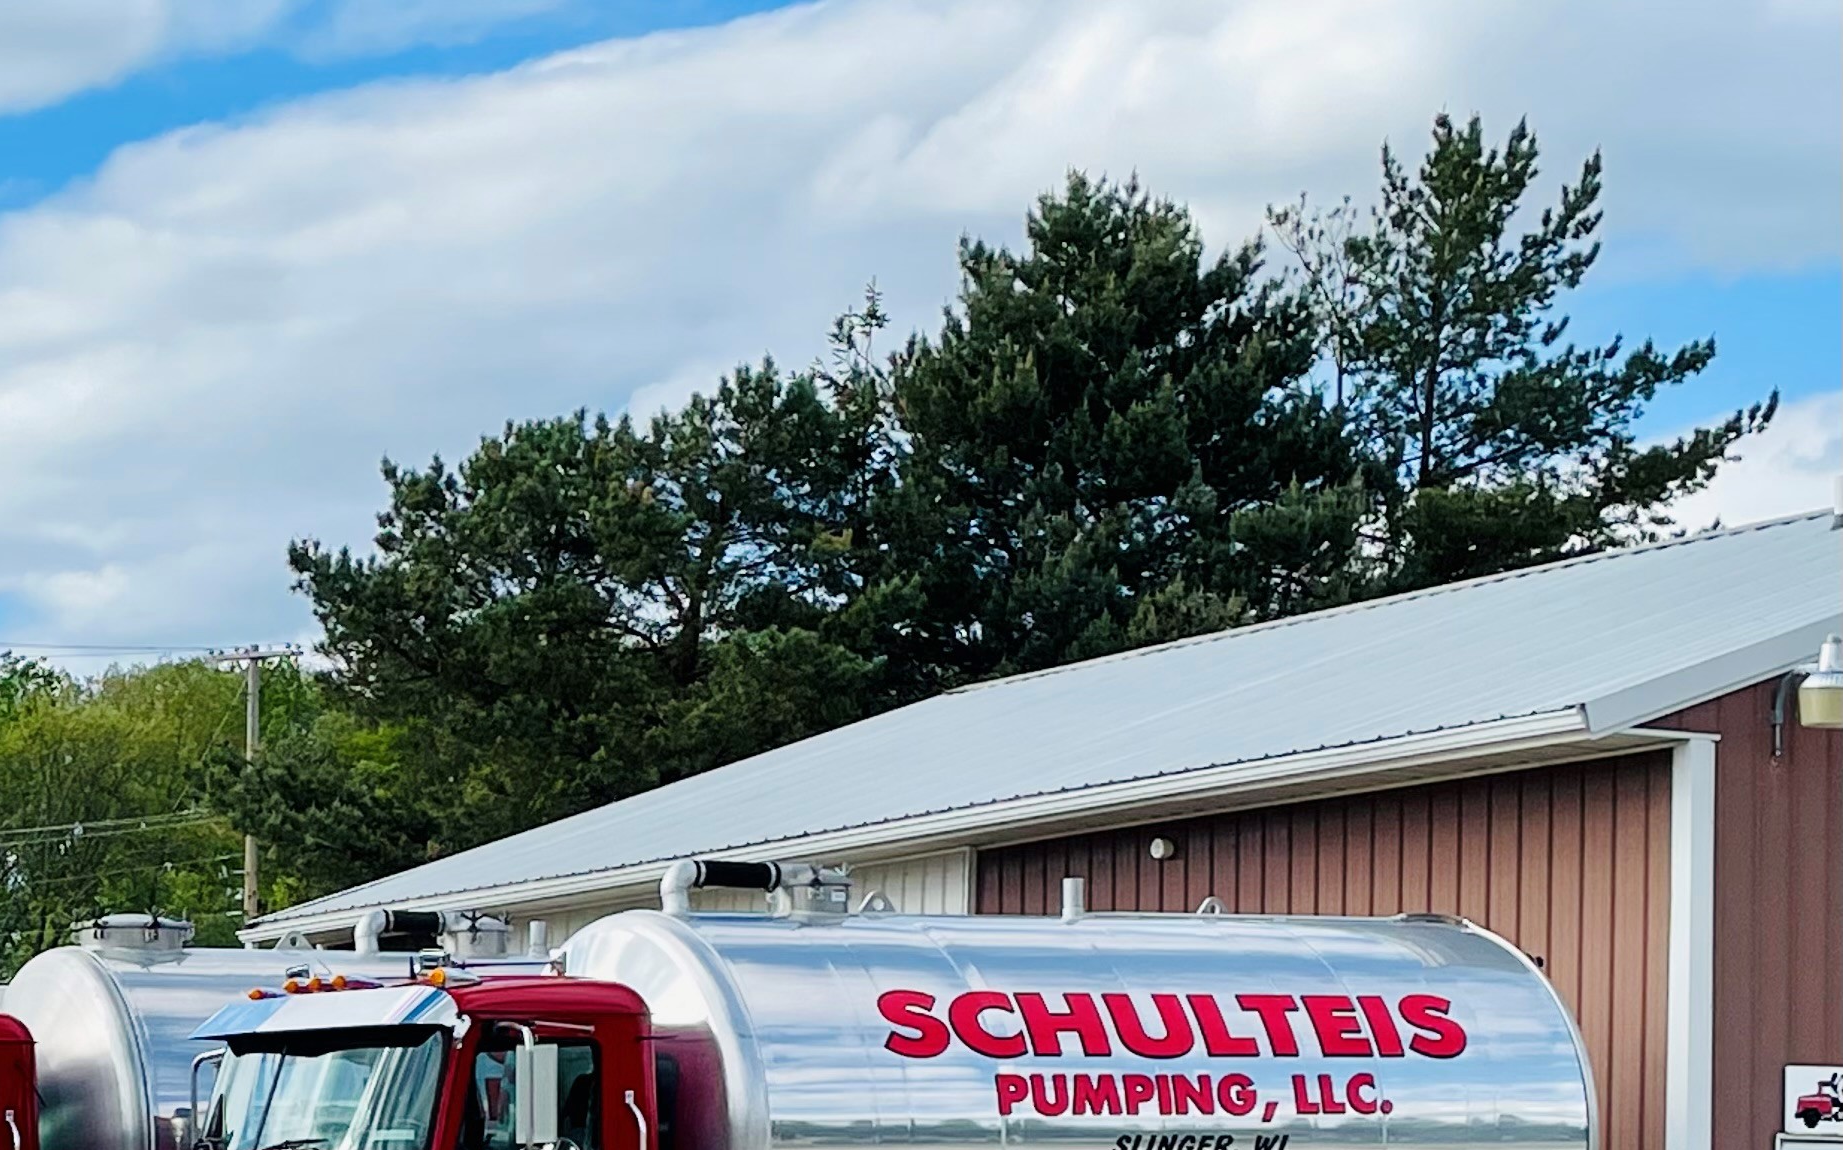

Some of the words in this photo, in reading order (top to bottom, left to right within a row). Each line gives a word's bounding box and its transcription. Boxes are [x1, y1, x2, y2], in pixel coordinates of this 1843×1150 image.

[876, 990, 1468, 1060] SCHULTEIS
[994, 1072, 1278, 1123] PUMPING,
[1291, 1072, 1394, 1115] LLC.
